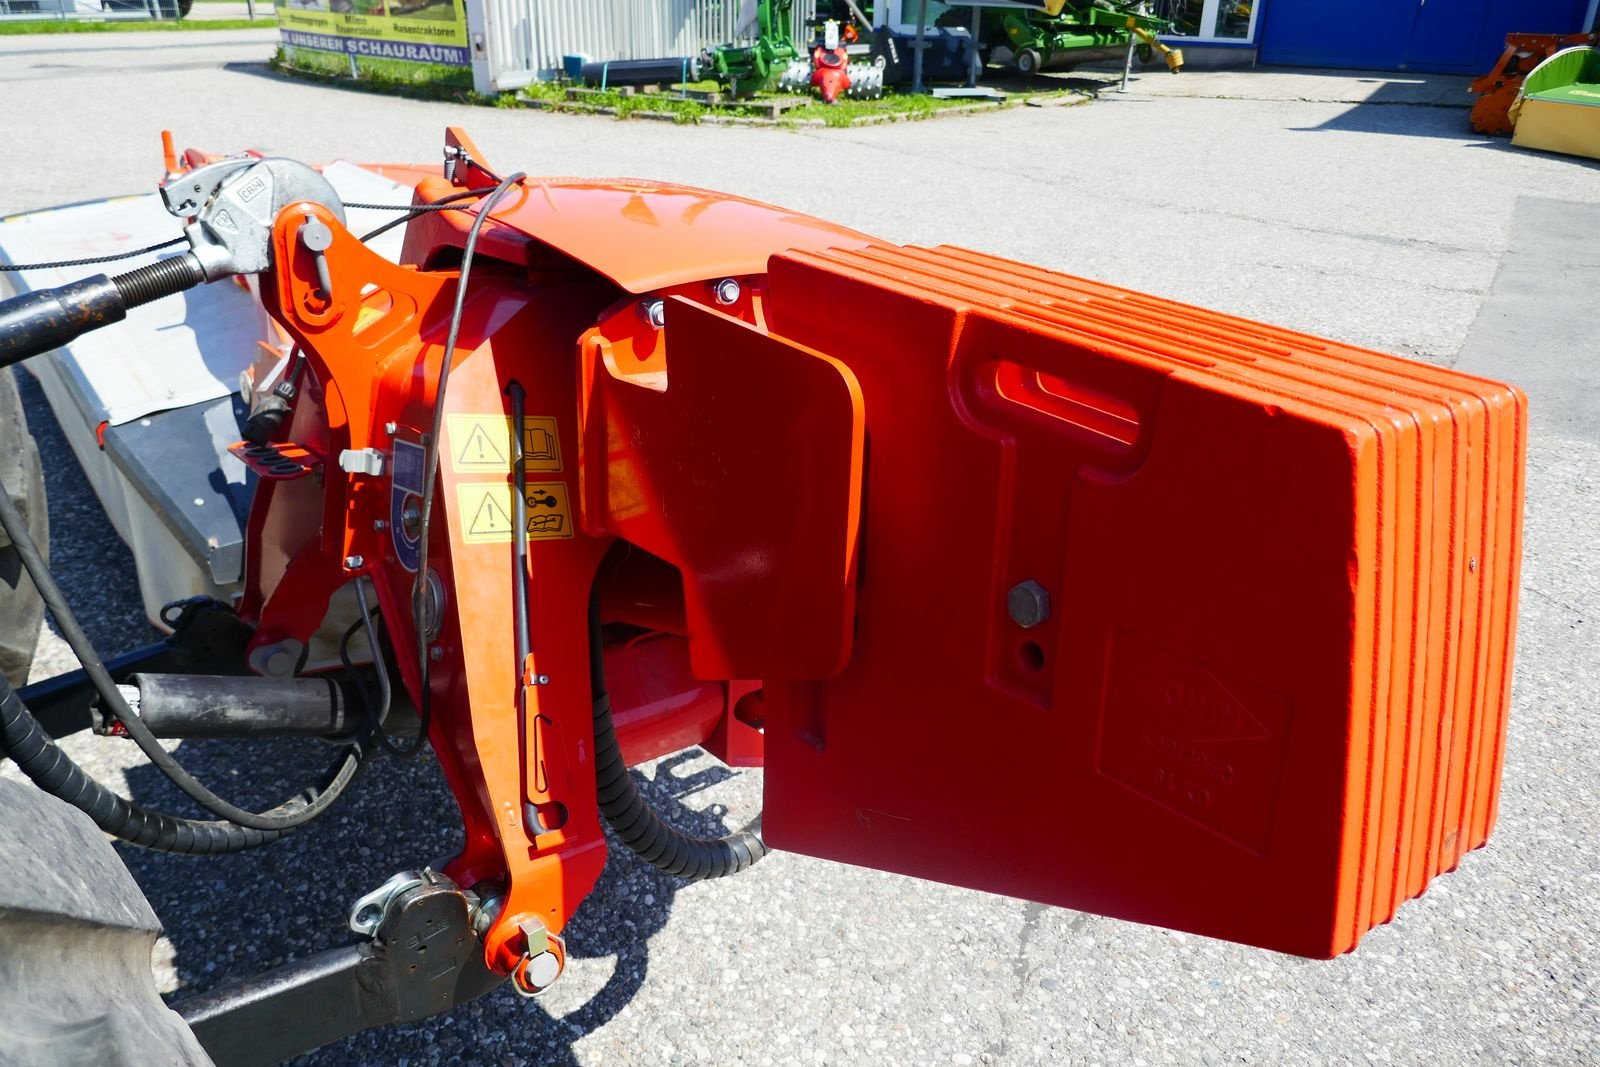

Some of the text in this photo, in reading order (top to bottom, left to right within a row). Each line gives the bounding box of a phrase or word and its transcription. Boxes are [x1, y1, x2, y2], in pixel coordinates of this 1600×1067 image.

[393, 23, 456, 38] Rasentraktoren
[291, 33, 343, 51] UNSEREN
[347, 40, 463, 63] SCHAURAUM!
